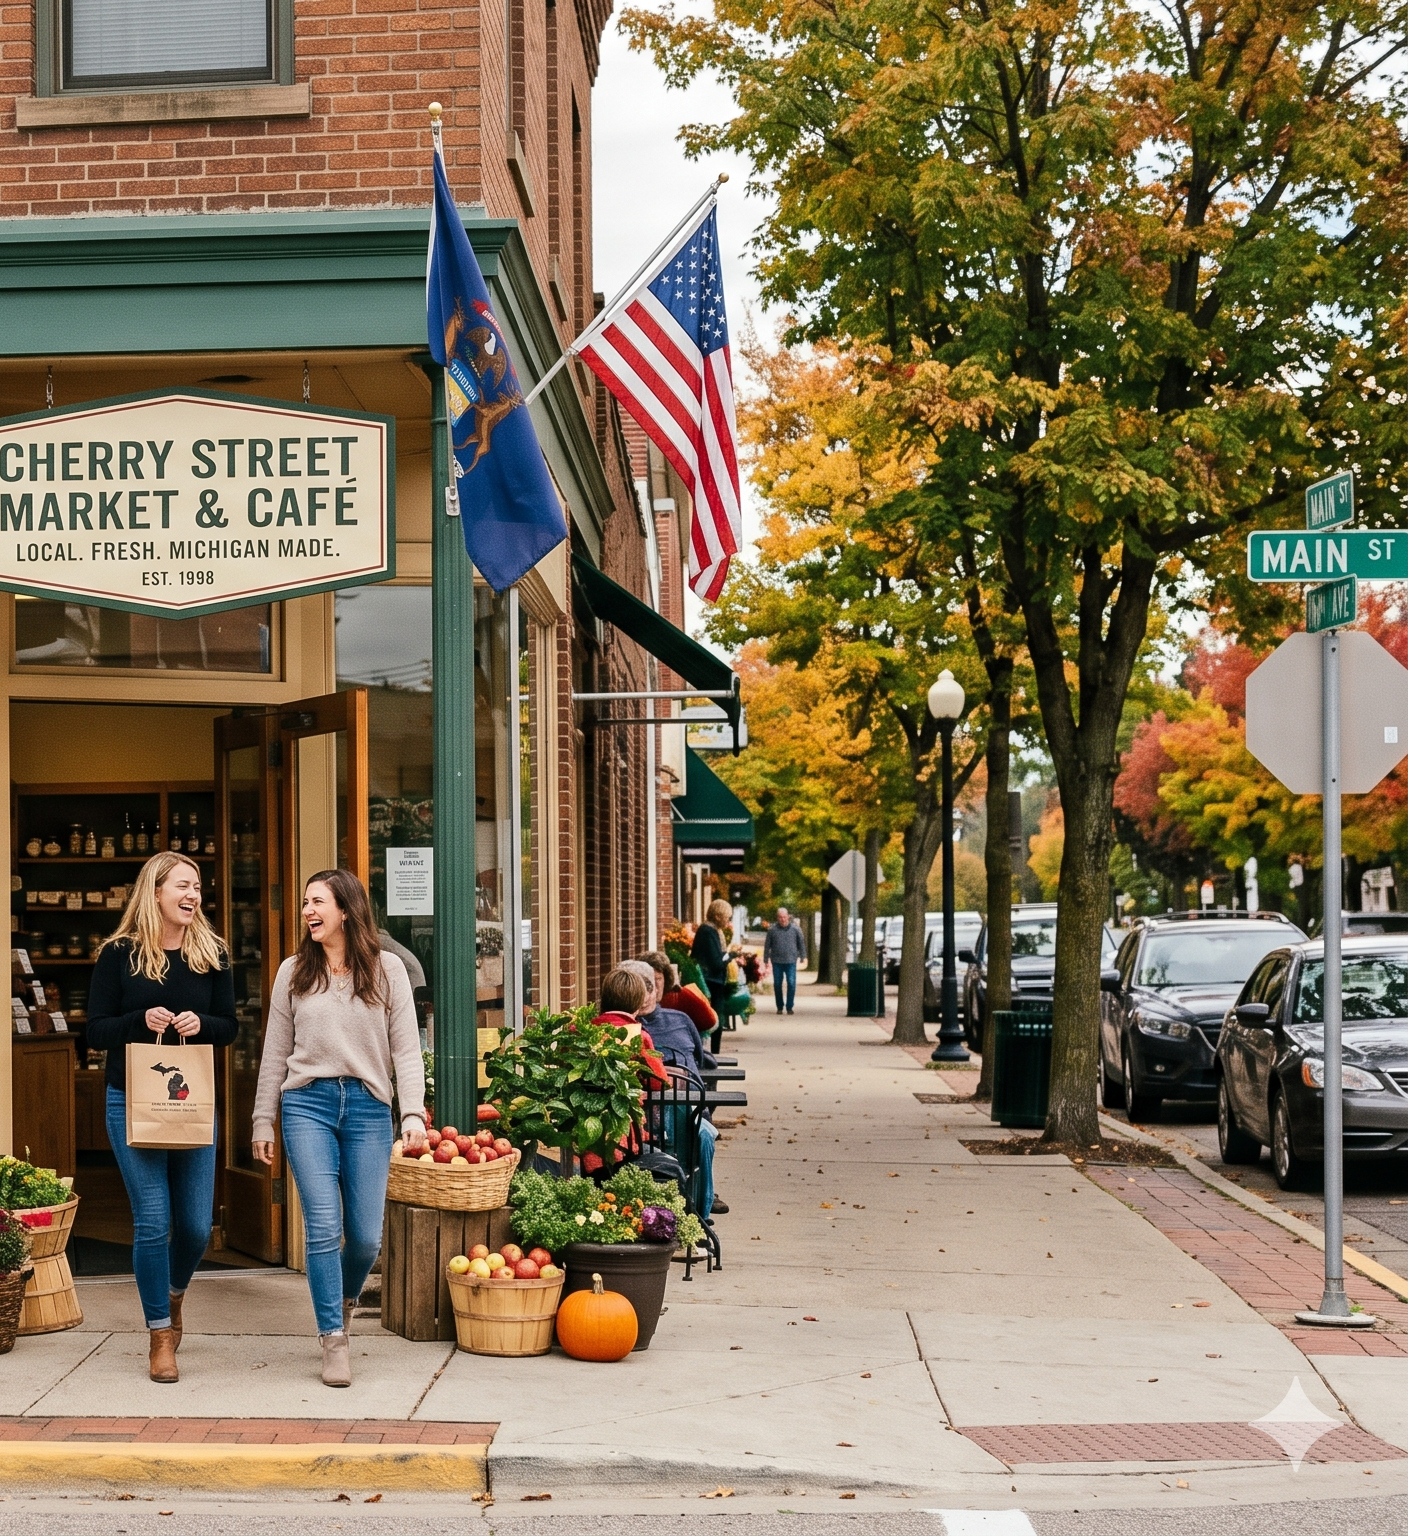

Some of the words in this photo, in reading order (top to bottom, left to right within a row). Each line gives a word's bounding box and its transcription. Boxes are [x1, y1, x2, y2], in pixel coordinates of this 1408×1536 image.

[191, 436, 359, 478] STREET
[0, 489, 180, 532] MARKET
[195, 488, 229, 529] &
[247, 477, 358, 528] CAFÉ
[1311, 485, 1336, 526] MAIN
[1339, 480, 1349, 504] ST
[16, 542, 83, 562] LOCAL.
[91, 541, 161, 561] FRESH.
[169, 539, 269, 560] MICHIGAN
[278, 538, 340, 558] MADE.
[1262, 538, 1348, 574] MAIN
[1367, 538, 1396, 561] ST
[142, 571, 172, 586] EST.
[178, 570, 214, 586] 1998
[1332, 583, 1350, 621] AVE
